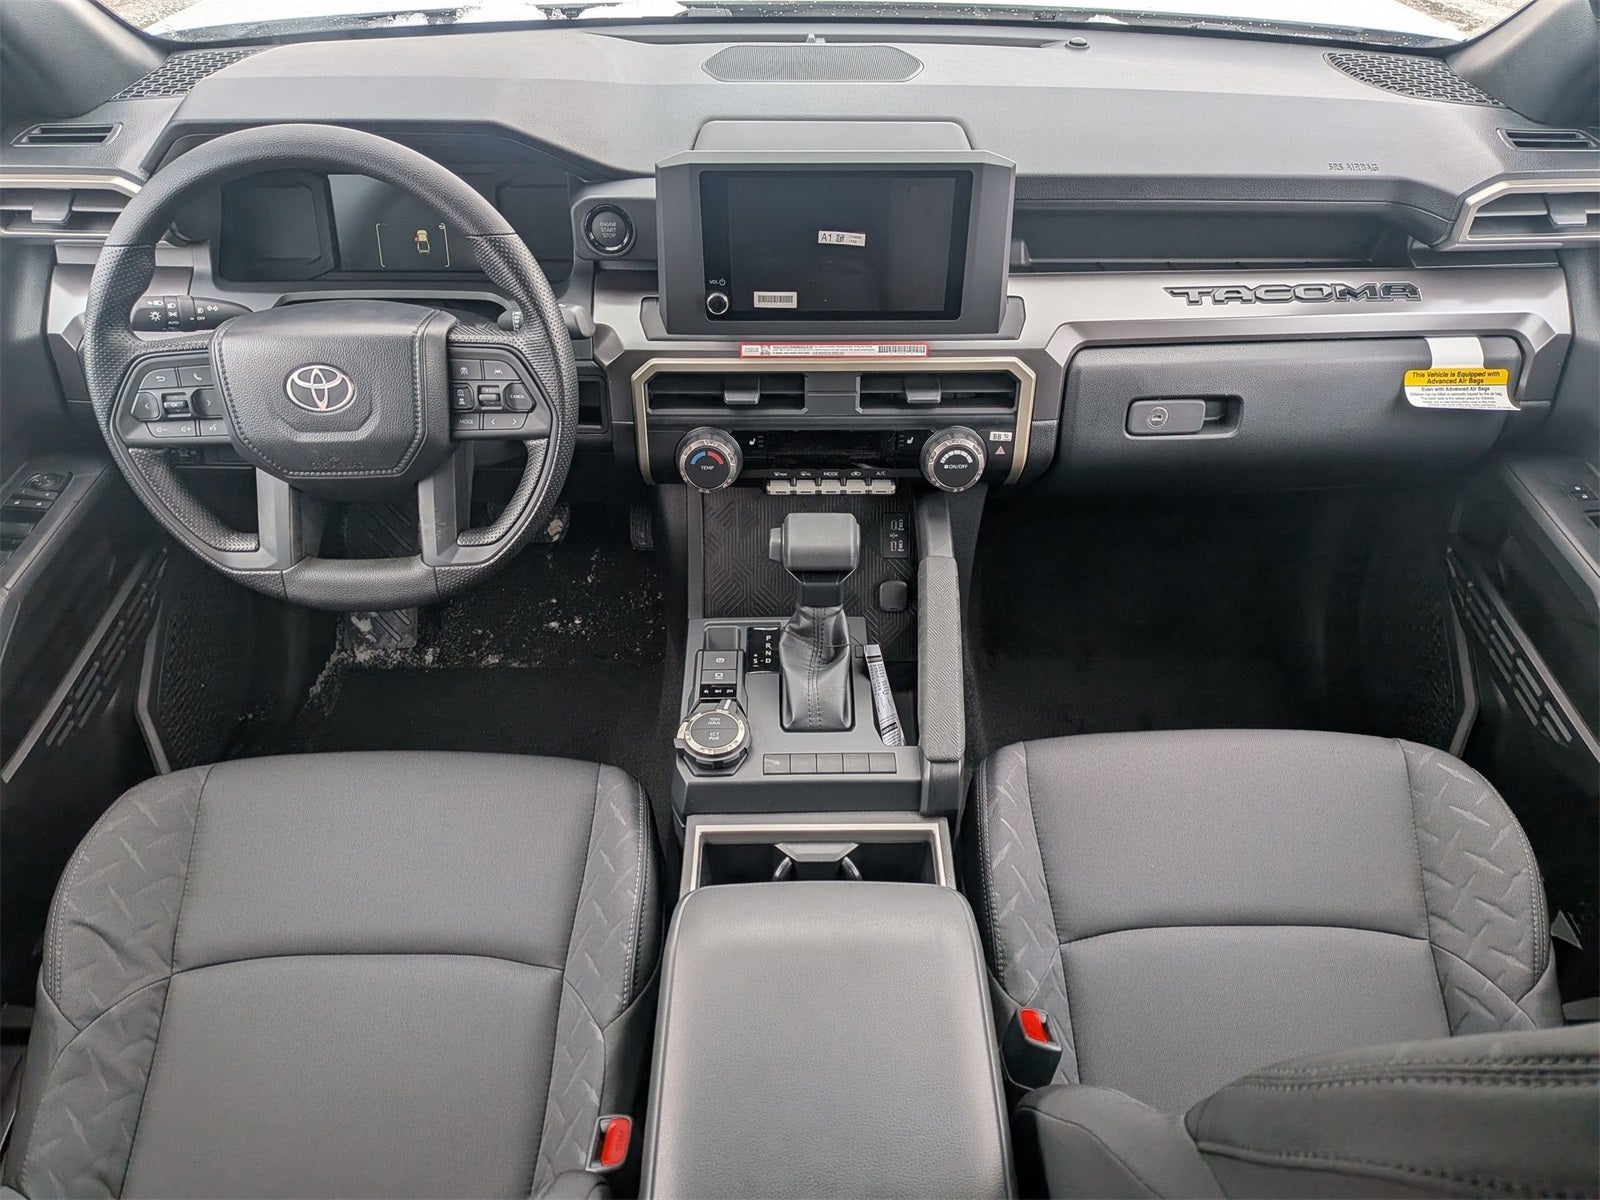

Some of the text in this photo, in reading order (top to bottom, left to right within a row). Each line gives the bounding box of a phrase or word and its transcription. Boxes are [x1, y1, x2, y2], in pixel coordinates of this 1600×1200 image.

[1328, 162, 1379, 172] SRS AIRBAG
[821, 232, 832, 243] A1
[1162, 281, 1422, 306] TACOMA
[765, 642, 772, 650] R
